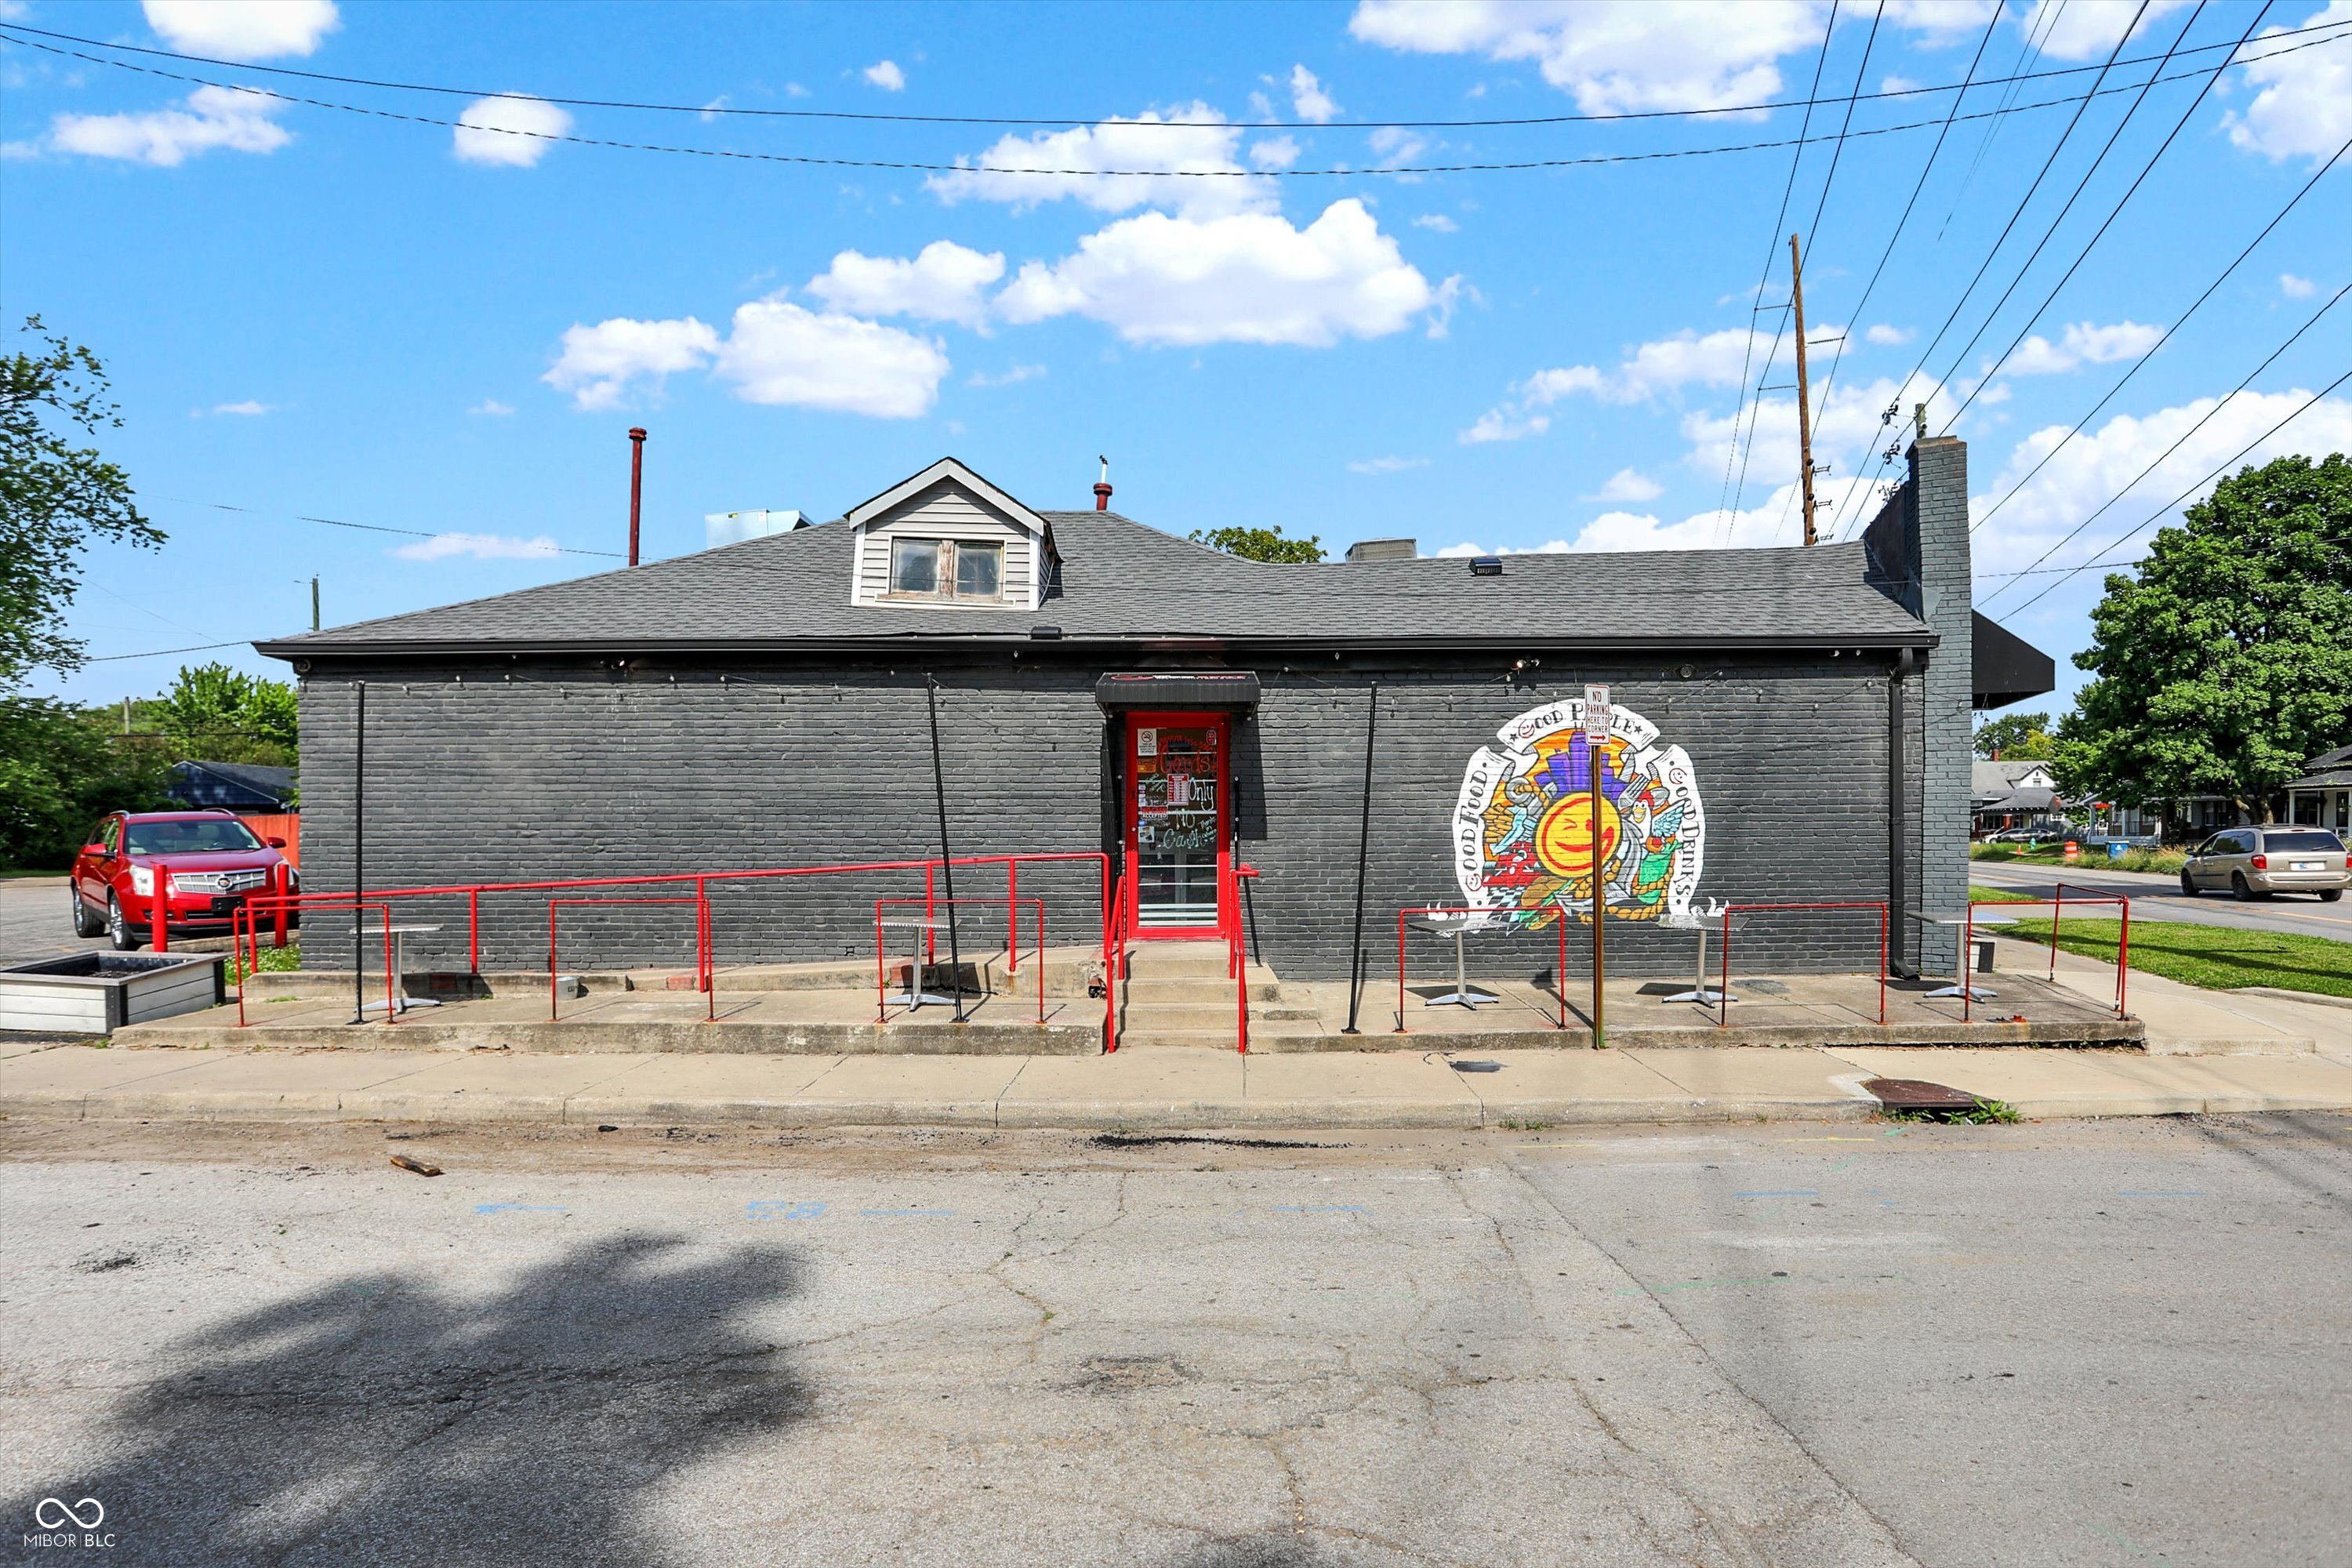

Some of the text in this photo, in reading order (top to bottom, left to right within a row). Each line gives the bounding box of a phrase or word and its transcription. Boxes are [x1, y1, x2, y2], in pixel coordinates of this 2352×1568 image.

[1592, 691, 1602, 702] NO
[1587, 703, 1609, 716] PARKING
[1588, 716, 1609, 724] HERE TO
[1189, 777, 1214, 811] Only
[1458, 770, 1487, 828] FOOD
[1672, 821, 1700, 897] DRINKS
